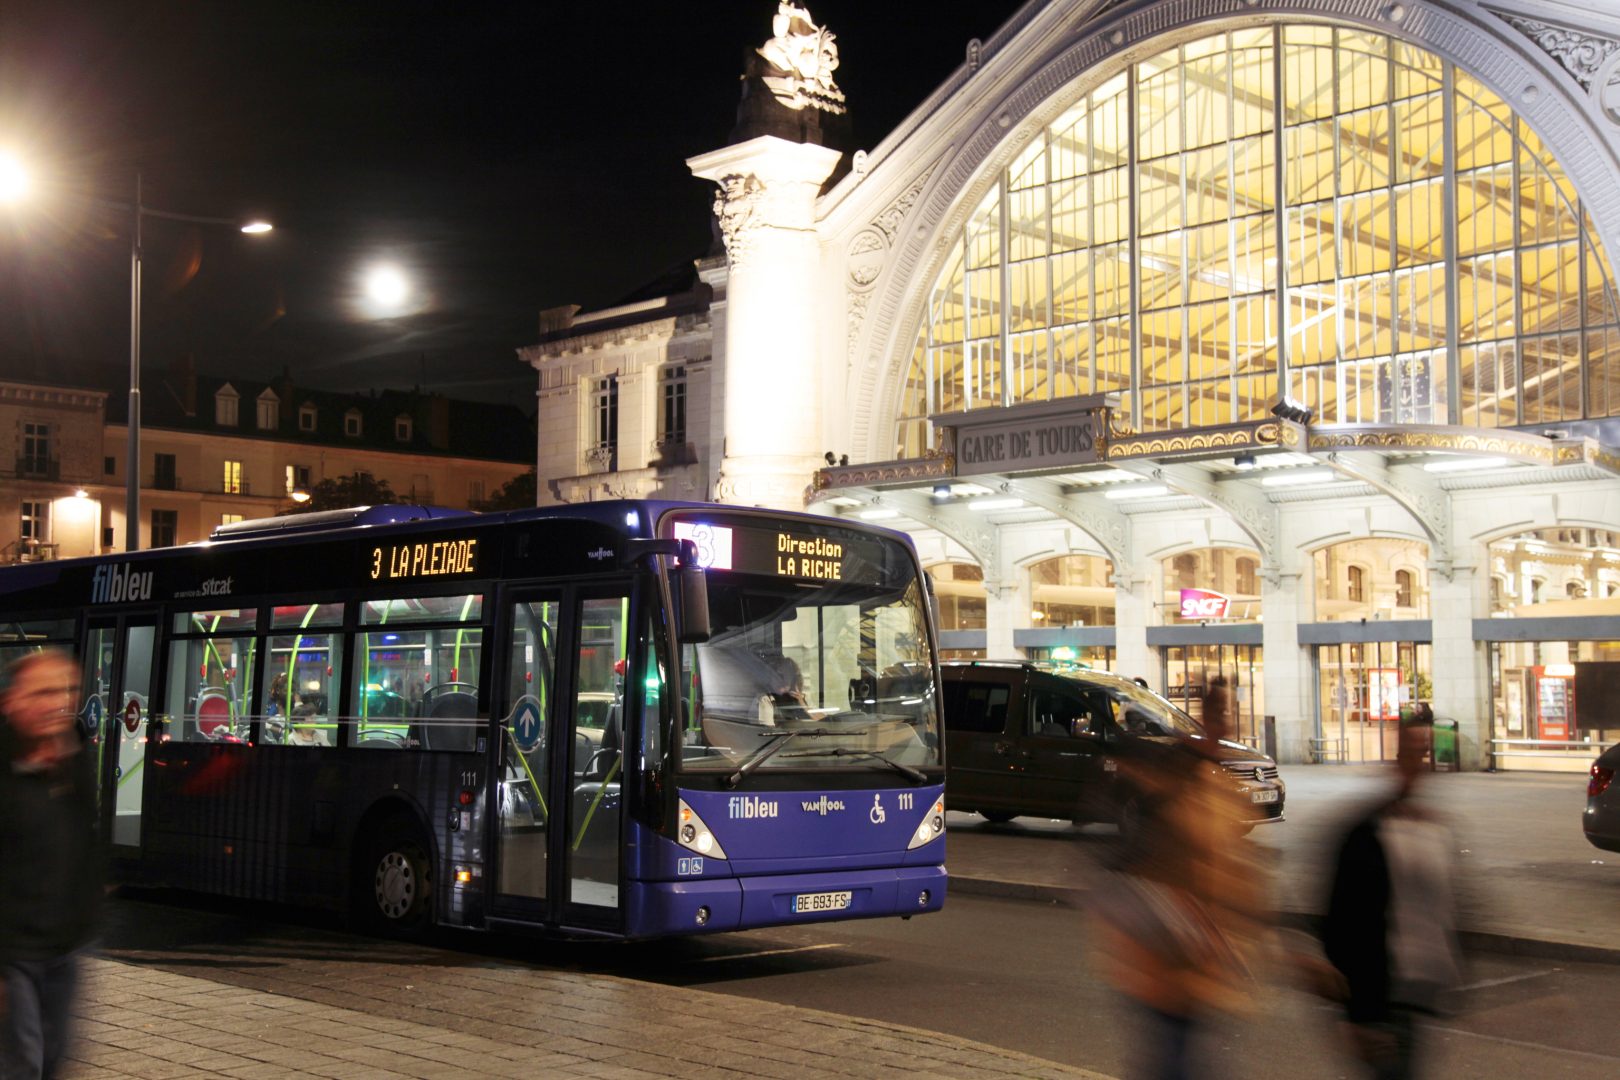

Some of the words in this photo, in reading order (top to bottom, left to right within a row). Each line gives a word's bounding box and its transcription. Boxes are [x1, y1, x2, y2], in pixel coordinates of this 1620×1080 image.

[961, 432, 1005, 464] GARE
[1009, 430, 1032, 459] DE
[1035, 423, 1093, 456] TOURS
[691, 523, 716, 568] 3
[777, 533, 842, 558] Direction
[371, 547, 382, 579] 3
[390, 545, 410, 578] LA
[412, 539, 477, 576] PLEIADE
[777, 556, 796, 576] LA
[801, 558, 842, 580] RICHE
[91, 562, 153, 604] filbleu
[201, 576, 235, 596] sitcat
[1181, 598, 1225, 616] SNCF
[461, 771, 477, 787] 111
[728, 796, 779, 819] filbleu
[898, 793, 914, 811] 111
